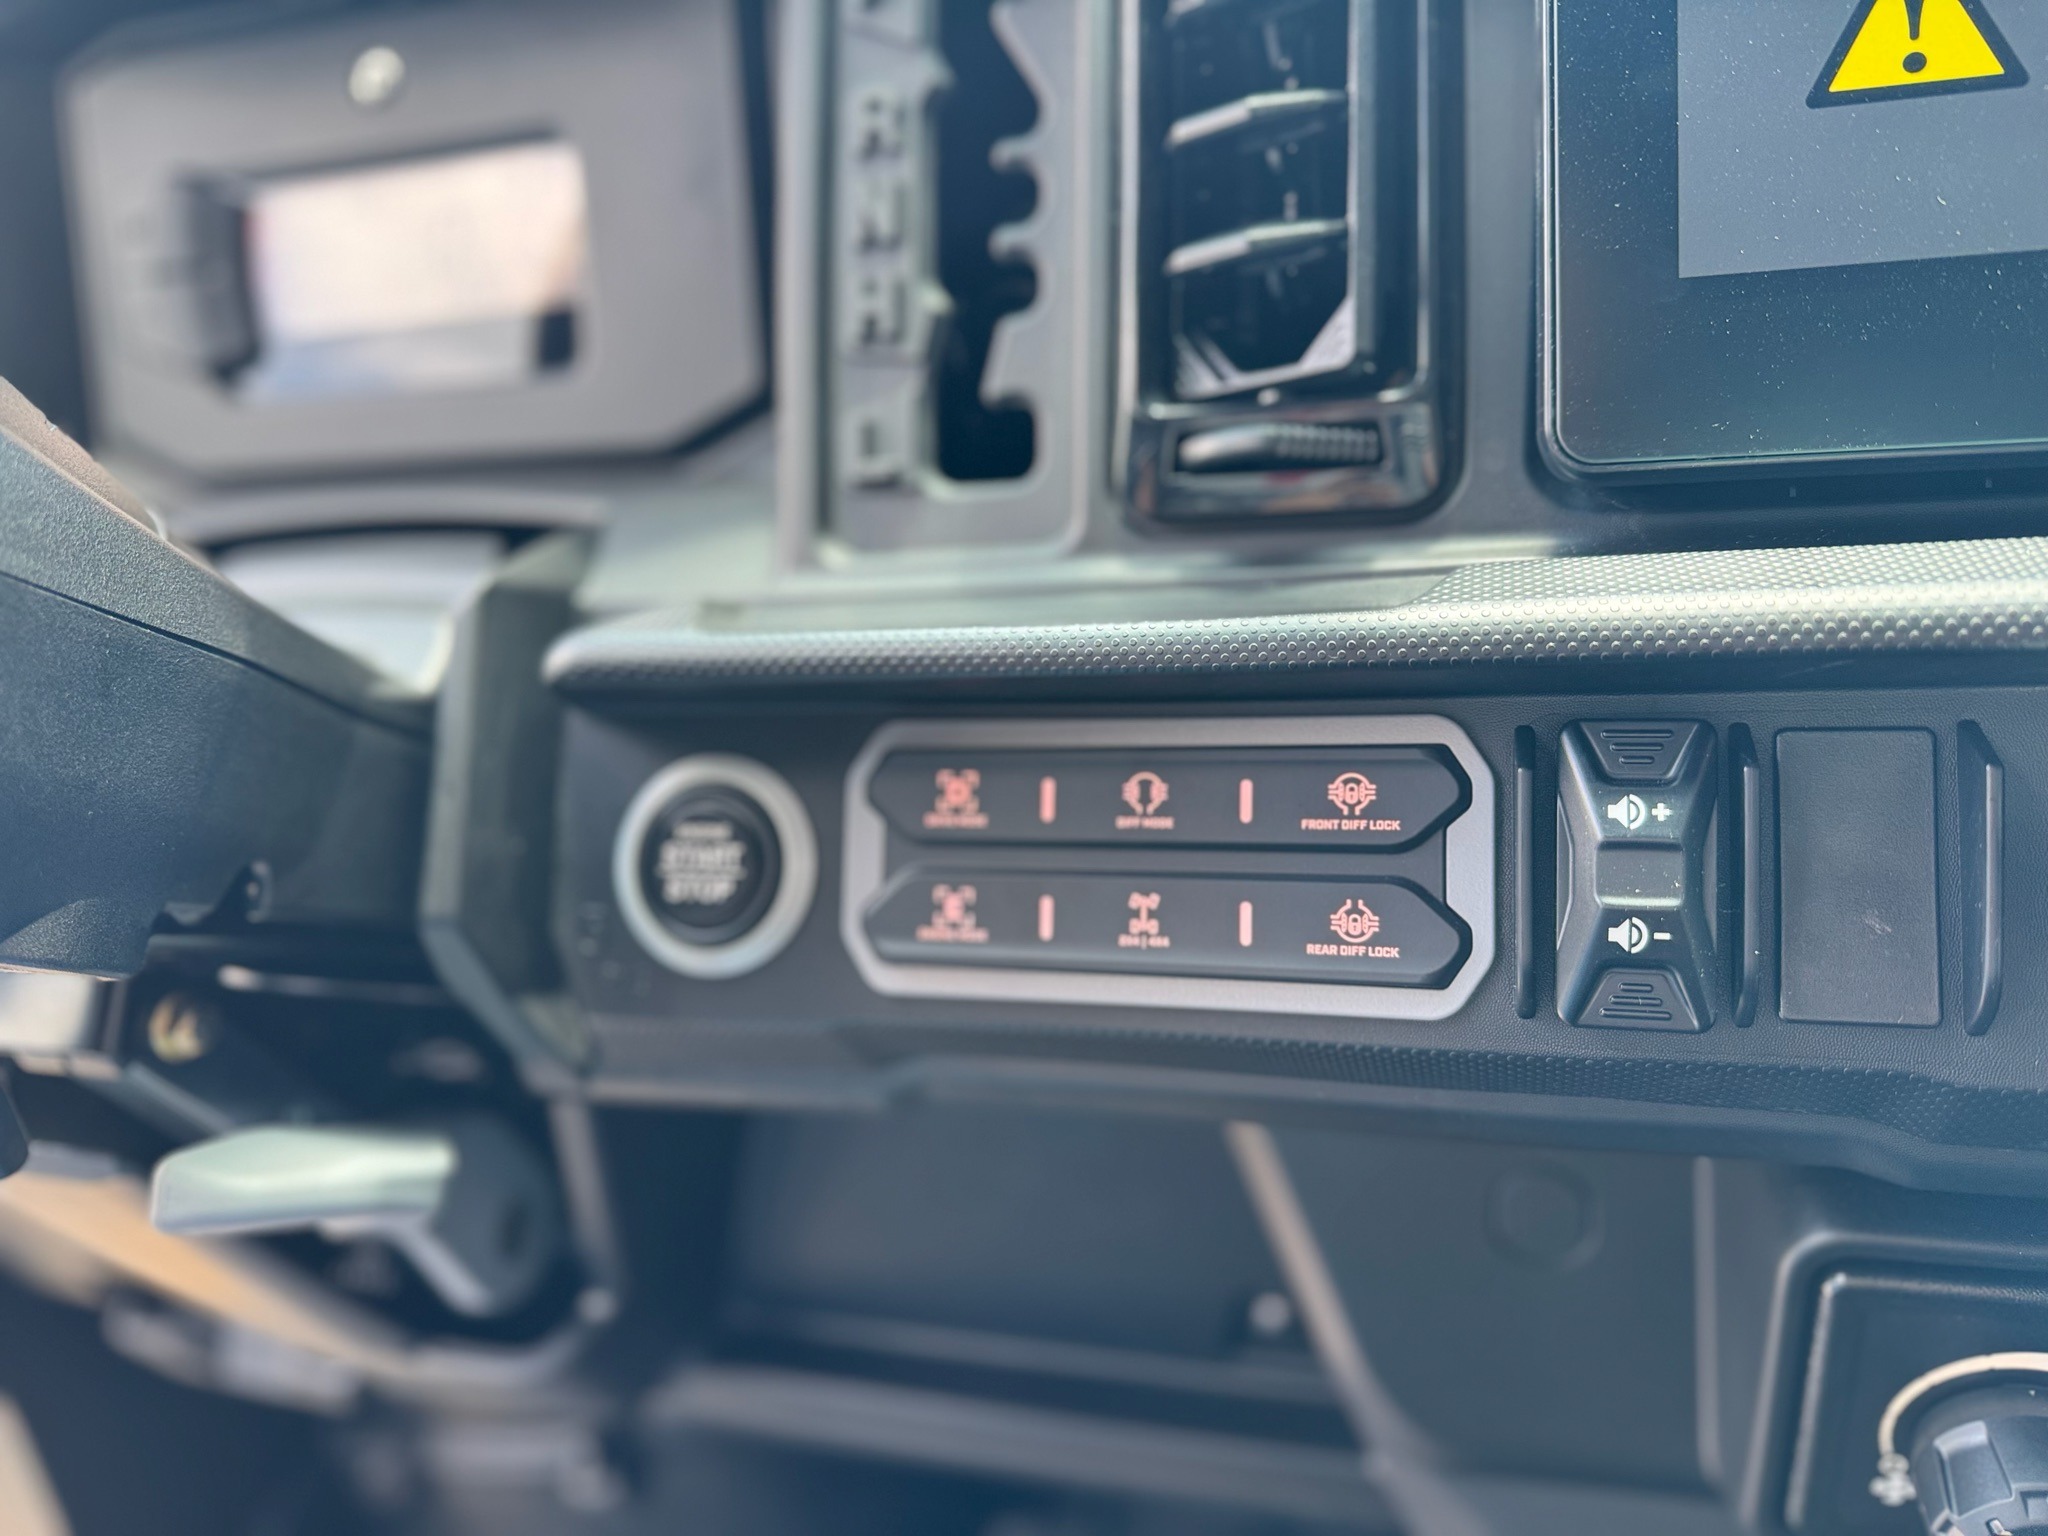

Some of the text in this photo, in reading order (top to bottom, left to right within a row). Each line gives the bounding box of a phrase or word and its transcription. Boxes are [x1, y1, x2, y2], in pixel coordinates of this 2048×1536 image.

[1301, 818, 1401, 831] FRONT DIFF LOCK
[660, 840, 746, 869] START
[663, 876, 737, 904] STOP
[1306, 943, 1400, 958] REAR DIFF LOCK
